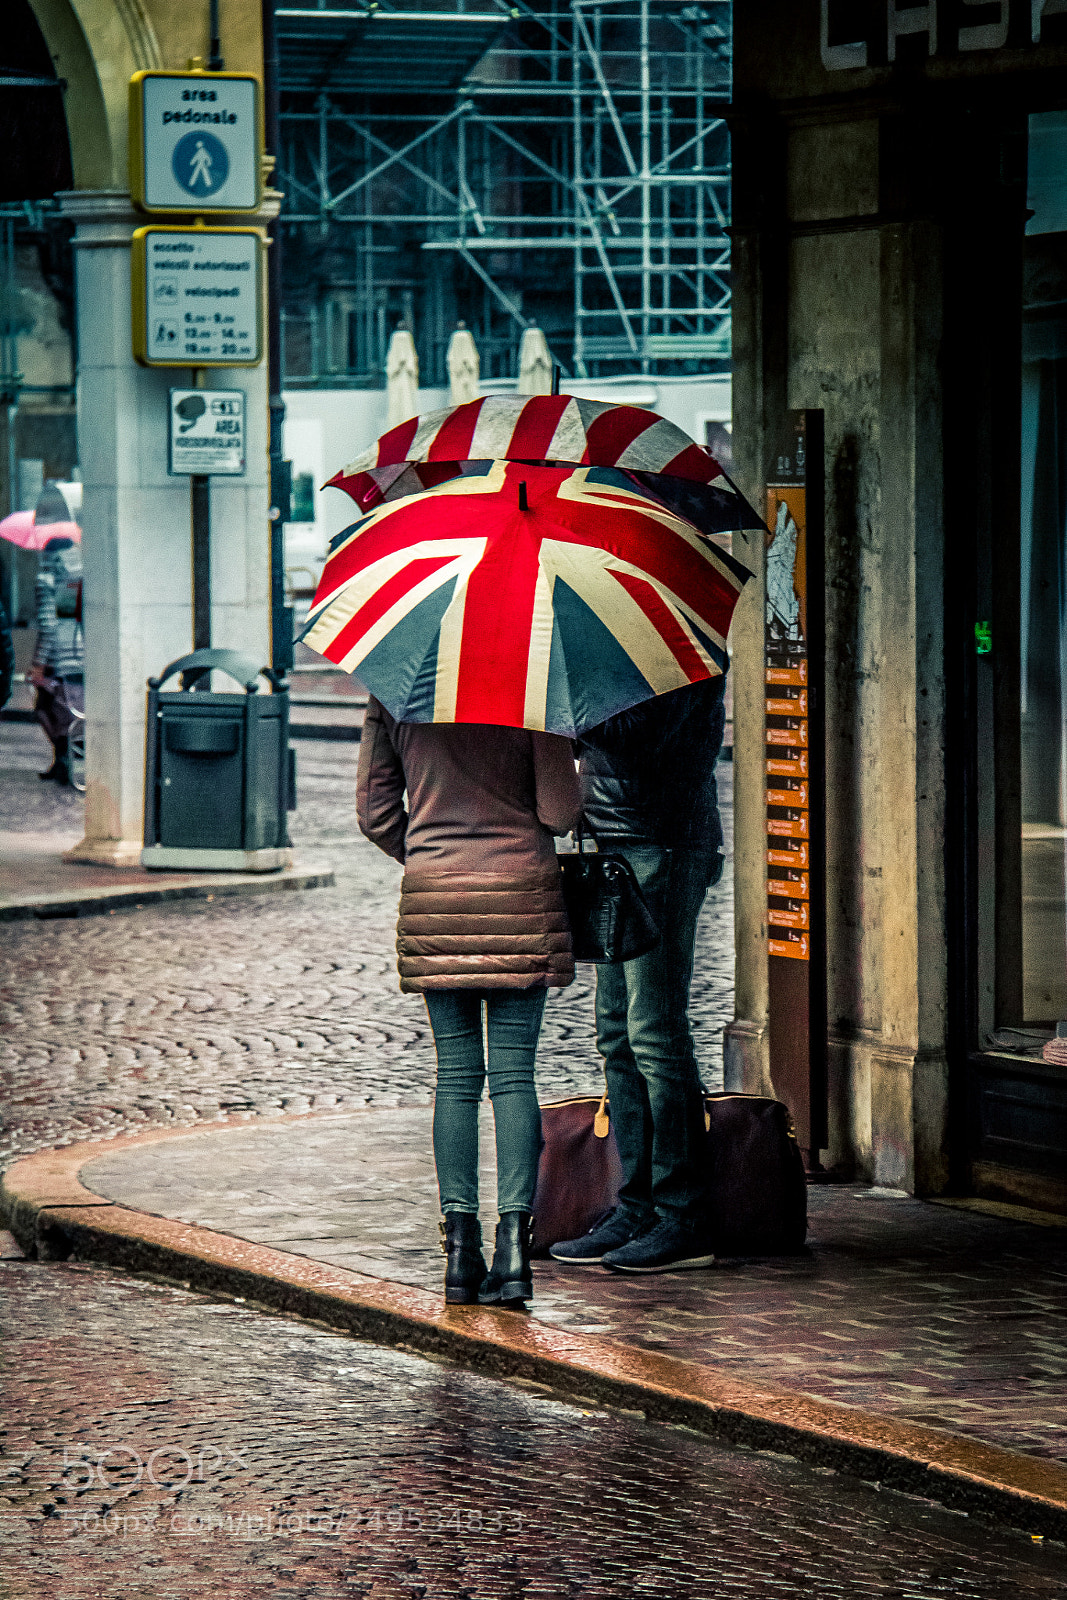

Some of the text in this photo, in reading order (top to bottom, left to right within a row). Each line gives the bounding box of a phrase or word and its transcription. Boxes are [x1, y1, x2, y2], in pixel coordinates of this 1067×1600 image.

[181, 89, 217, 102] area
[162, 107, 237, 125] pedonale
[215, 420, 241, 434] AREA
